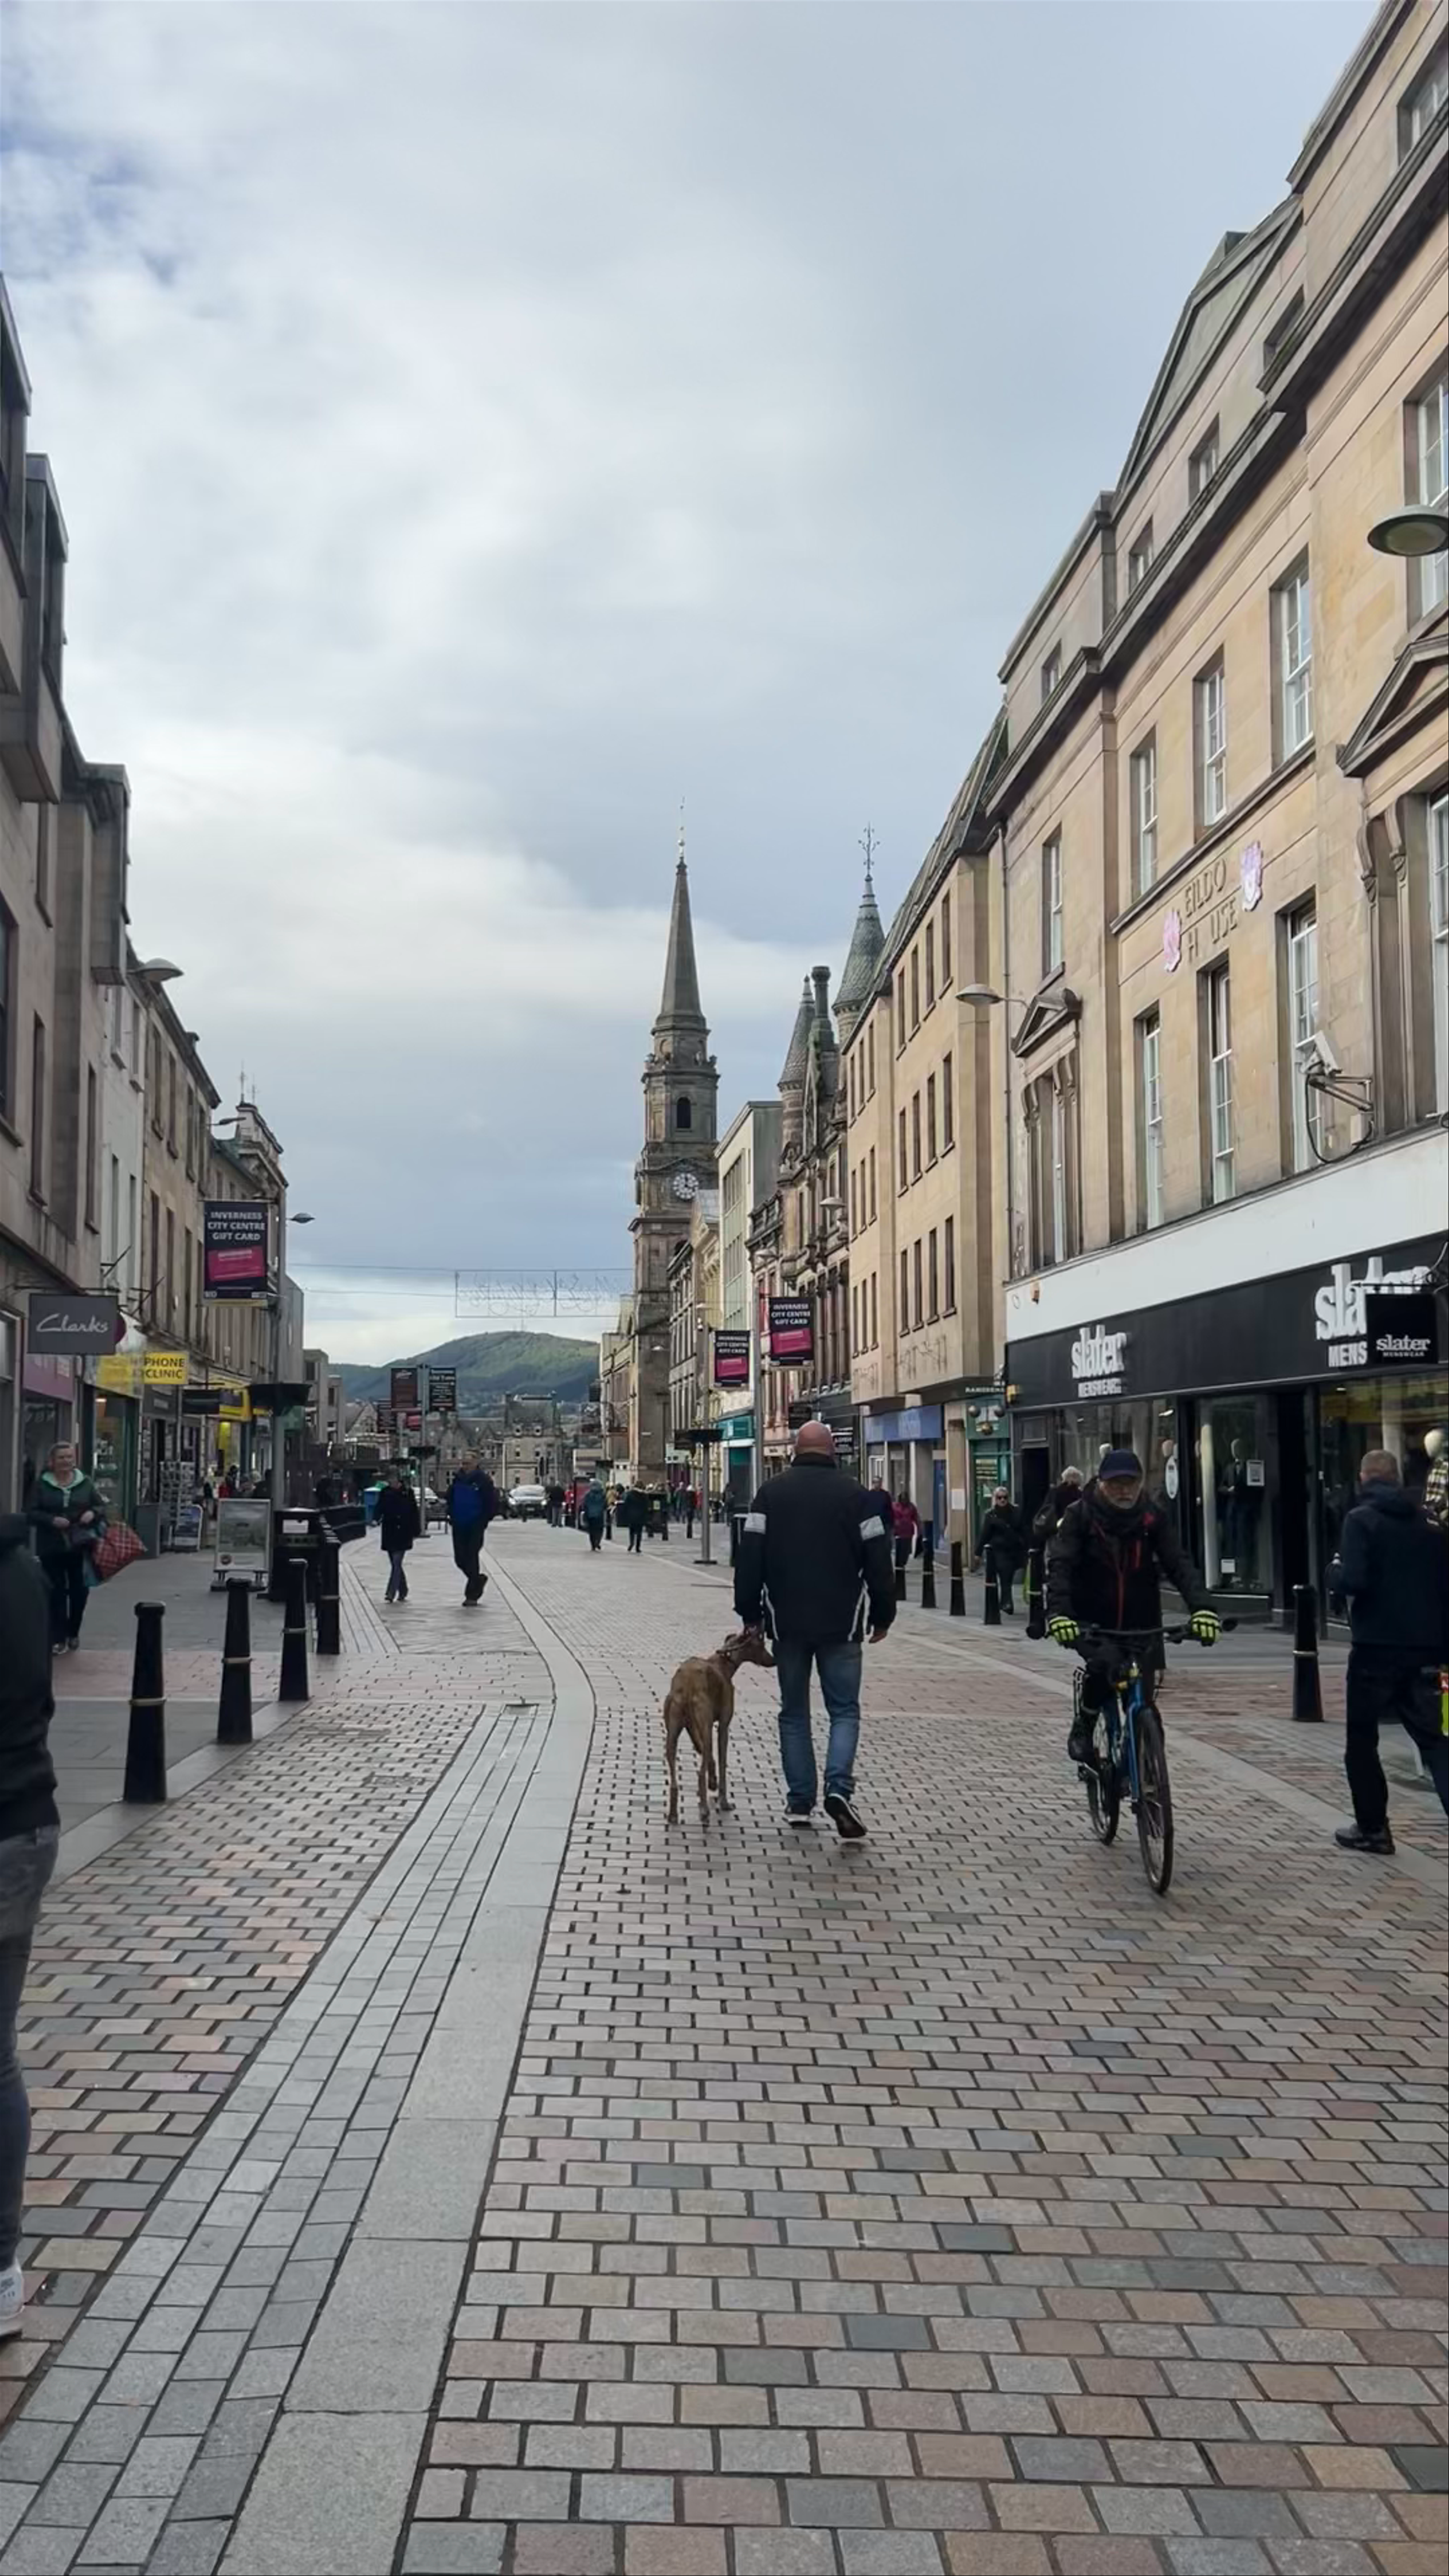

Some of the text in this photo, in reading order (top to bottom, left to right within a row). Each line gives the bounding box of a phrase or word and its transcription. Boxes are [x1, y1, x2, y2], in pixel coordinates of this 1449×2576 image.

[37, 1313, 108, 1333] Clarks
[1377, 1334, 1431, 1351] slater
[1071, 1325, 1127, 1378] slater
[145, 1358, 185, 1367] PHONE
[145, 1369, 182, 1379] CLINIC
